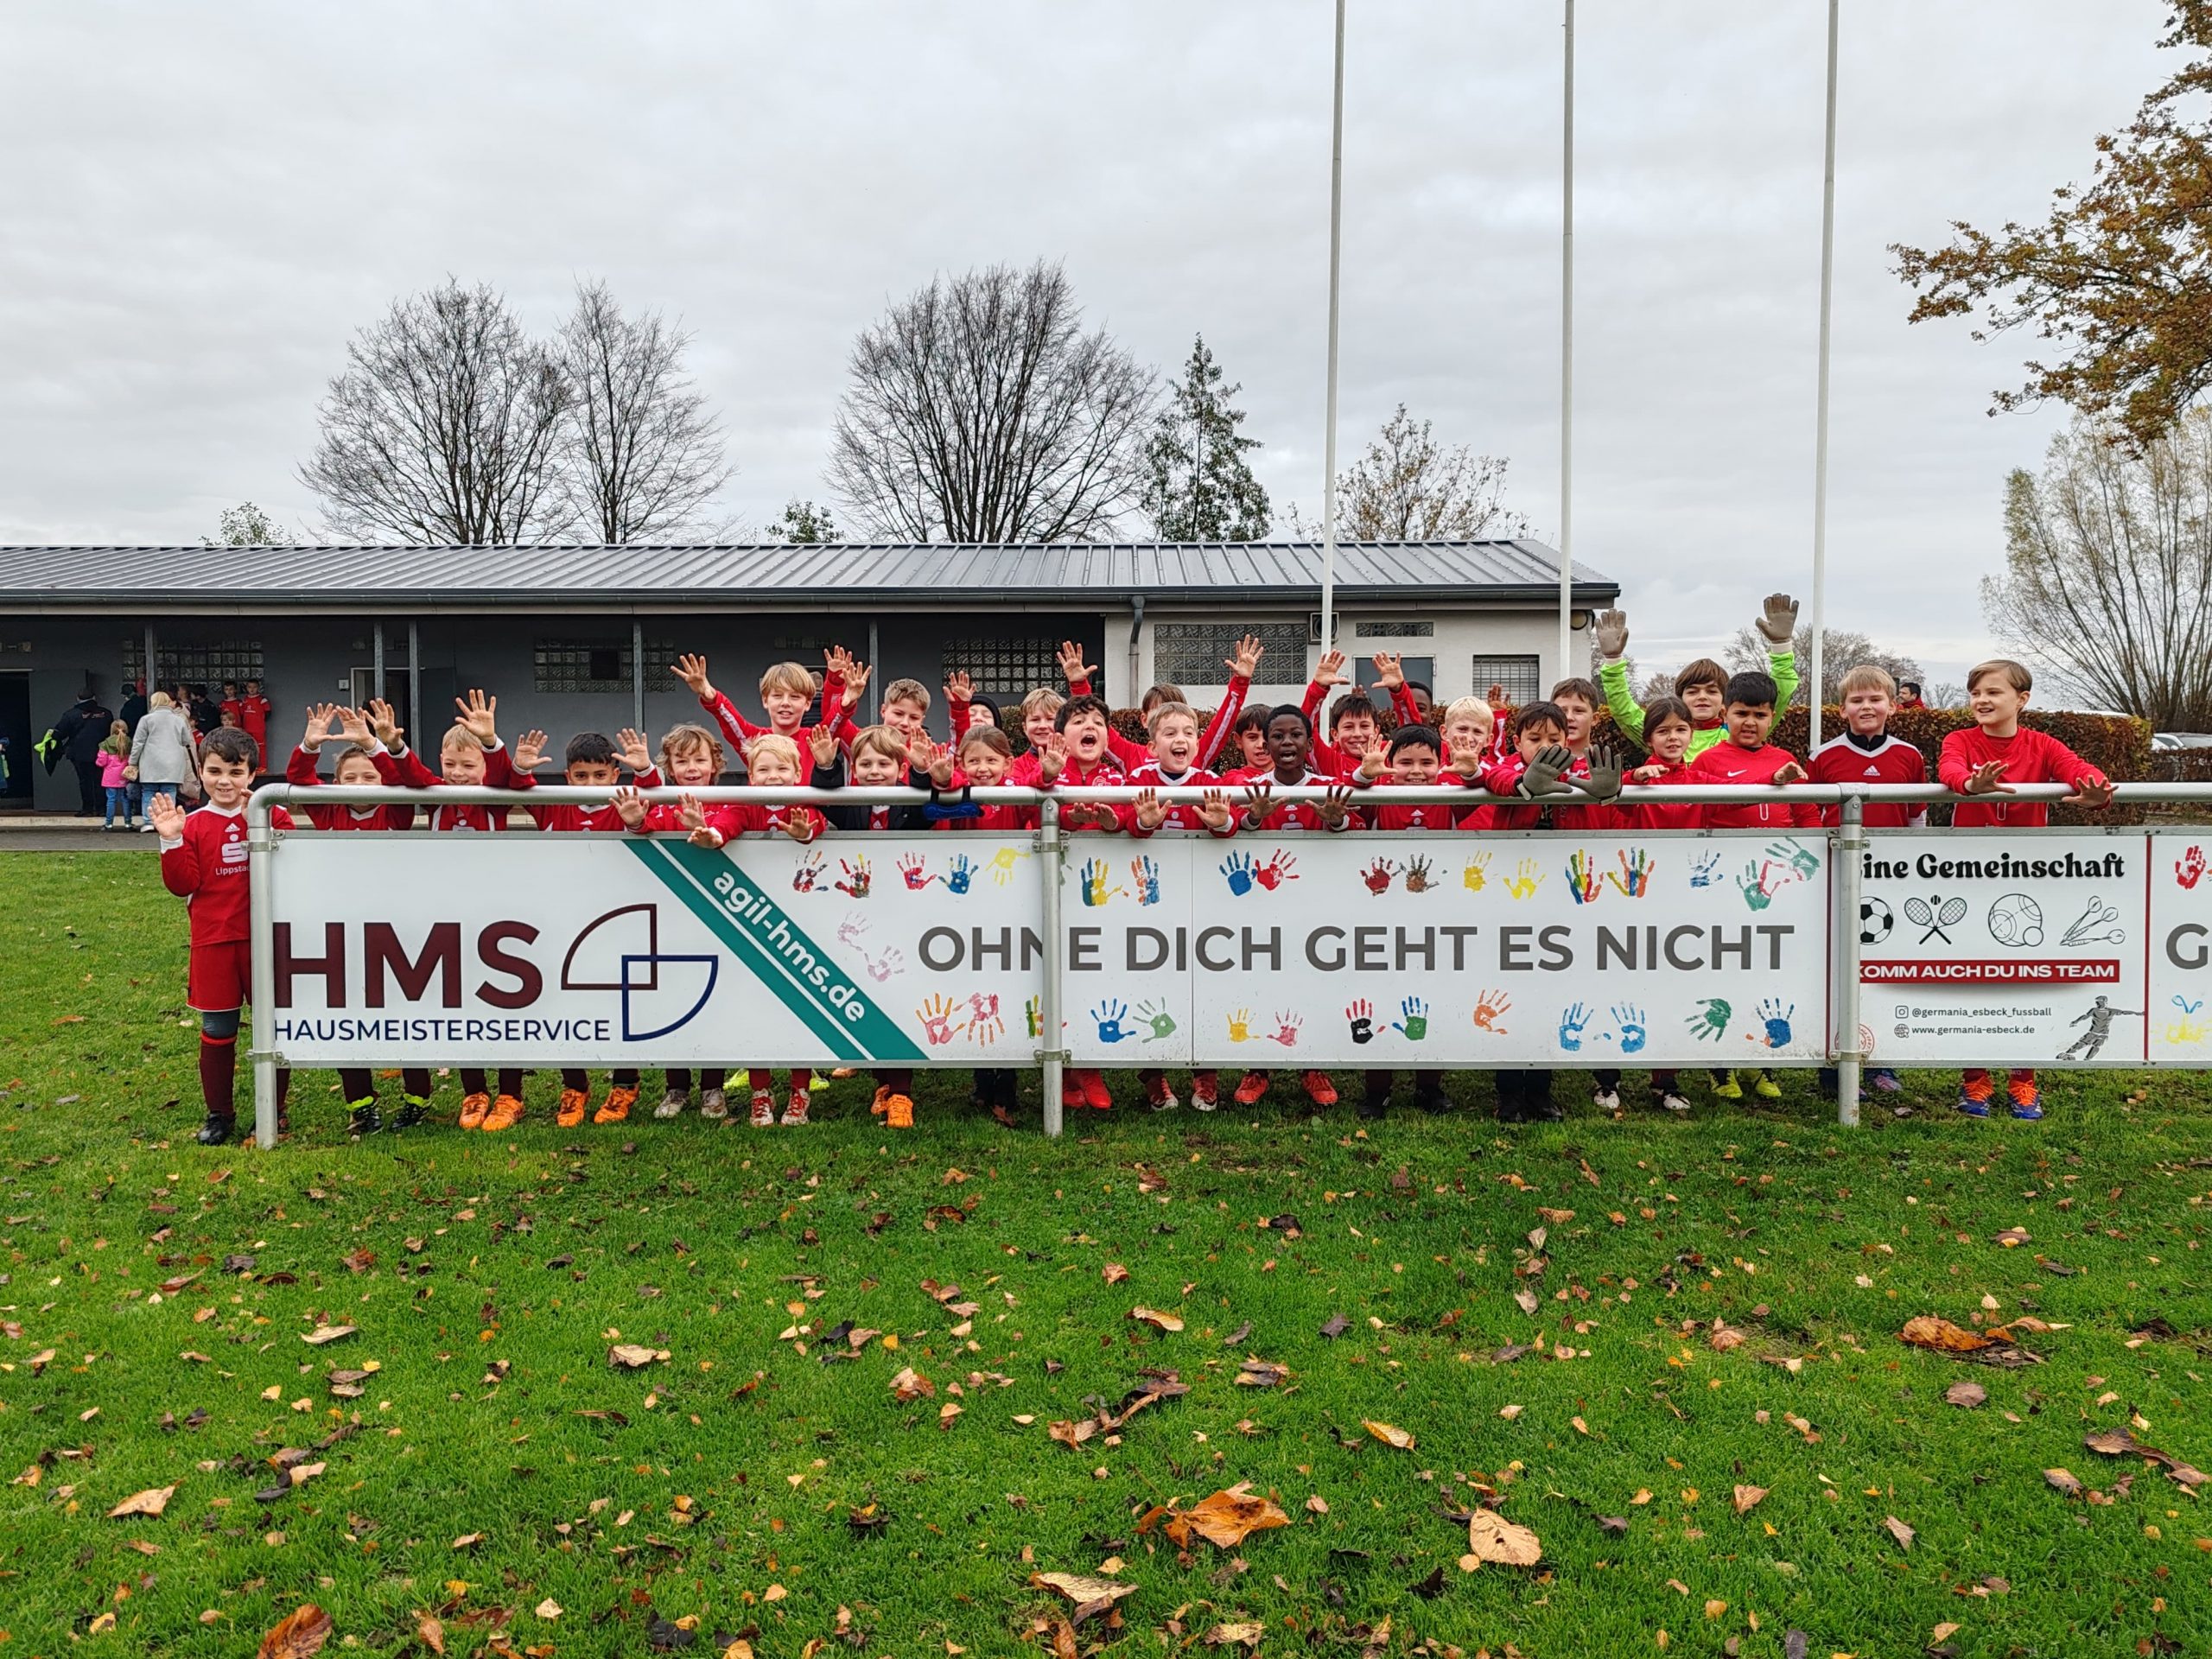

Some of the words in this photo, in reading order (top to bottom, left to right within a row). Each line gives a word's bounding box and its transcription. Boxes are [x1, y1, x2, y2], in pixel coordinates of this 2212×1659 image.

[1860, 853, 1910, 879] ine
[1916, 852, 2126, 879] Gemeinschaft
[714, 871, 865, 1022] agil-hms.de
[1126, 926, 1281, 971] DICH
[1305, 925, 1478, 972] GEHT
[1499, 925, 1573, 972] ES
[1597, 925, 1796, 971] NICHT
[273, 920, 543, 1009] HMS
[1921, 964, 1980, 978] AUCH
[1985, 964, 2015, 978] DU
[2018, 964, 2052, 978] INS
[2056, 964, 2114, 977] TEAM
[1911, 1007, 2052, 1018] @germania_esbeck_fussball
[275, 1019, 611, 1041] HAUSMEISTERSERVICE
[1911, 1026, 2036, 1036] www.germania-esbeck.de
